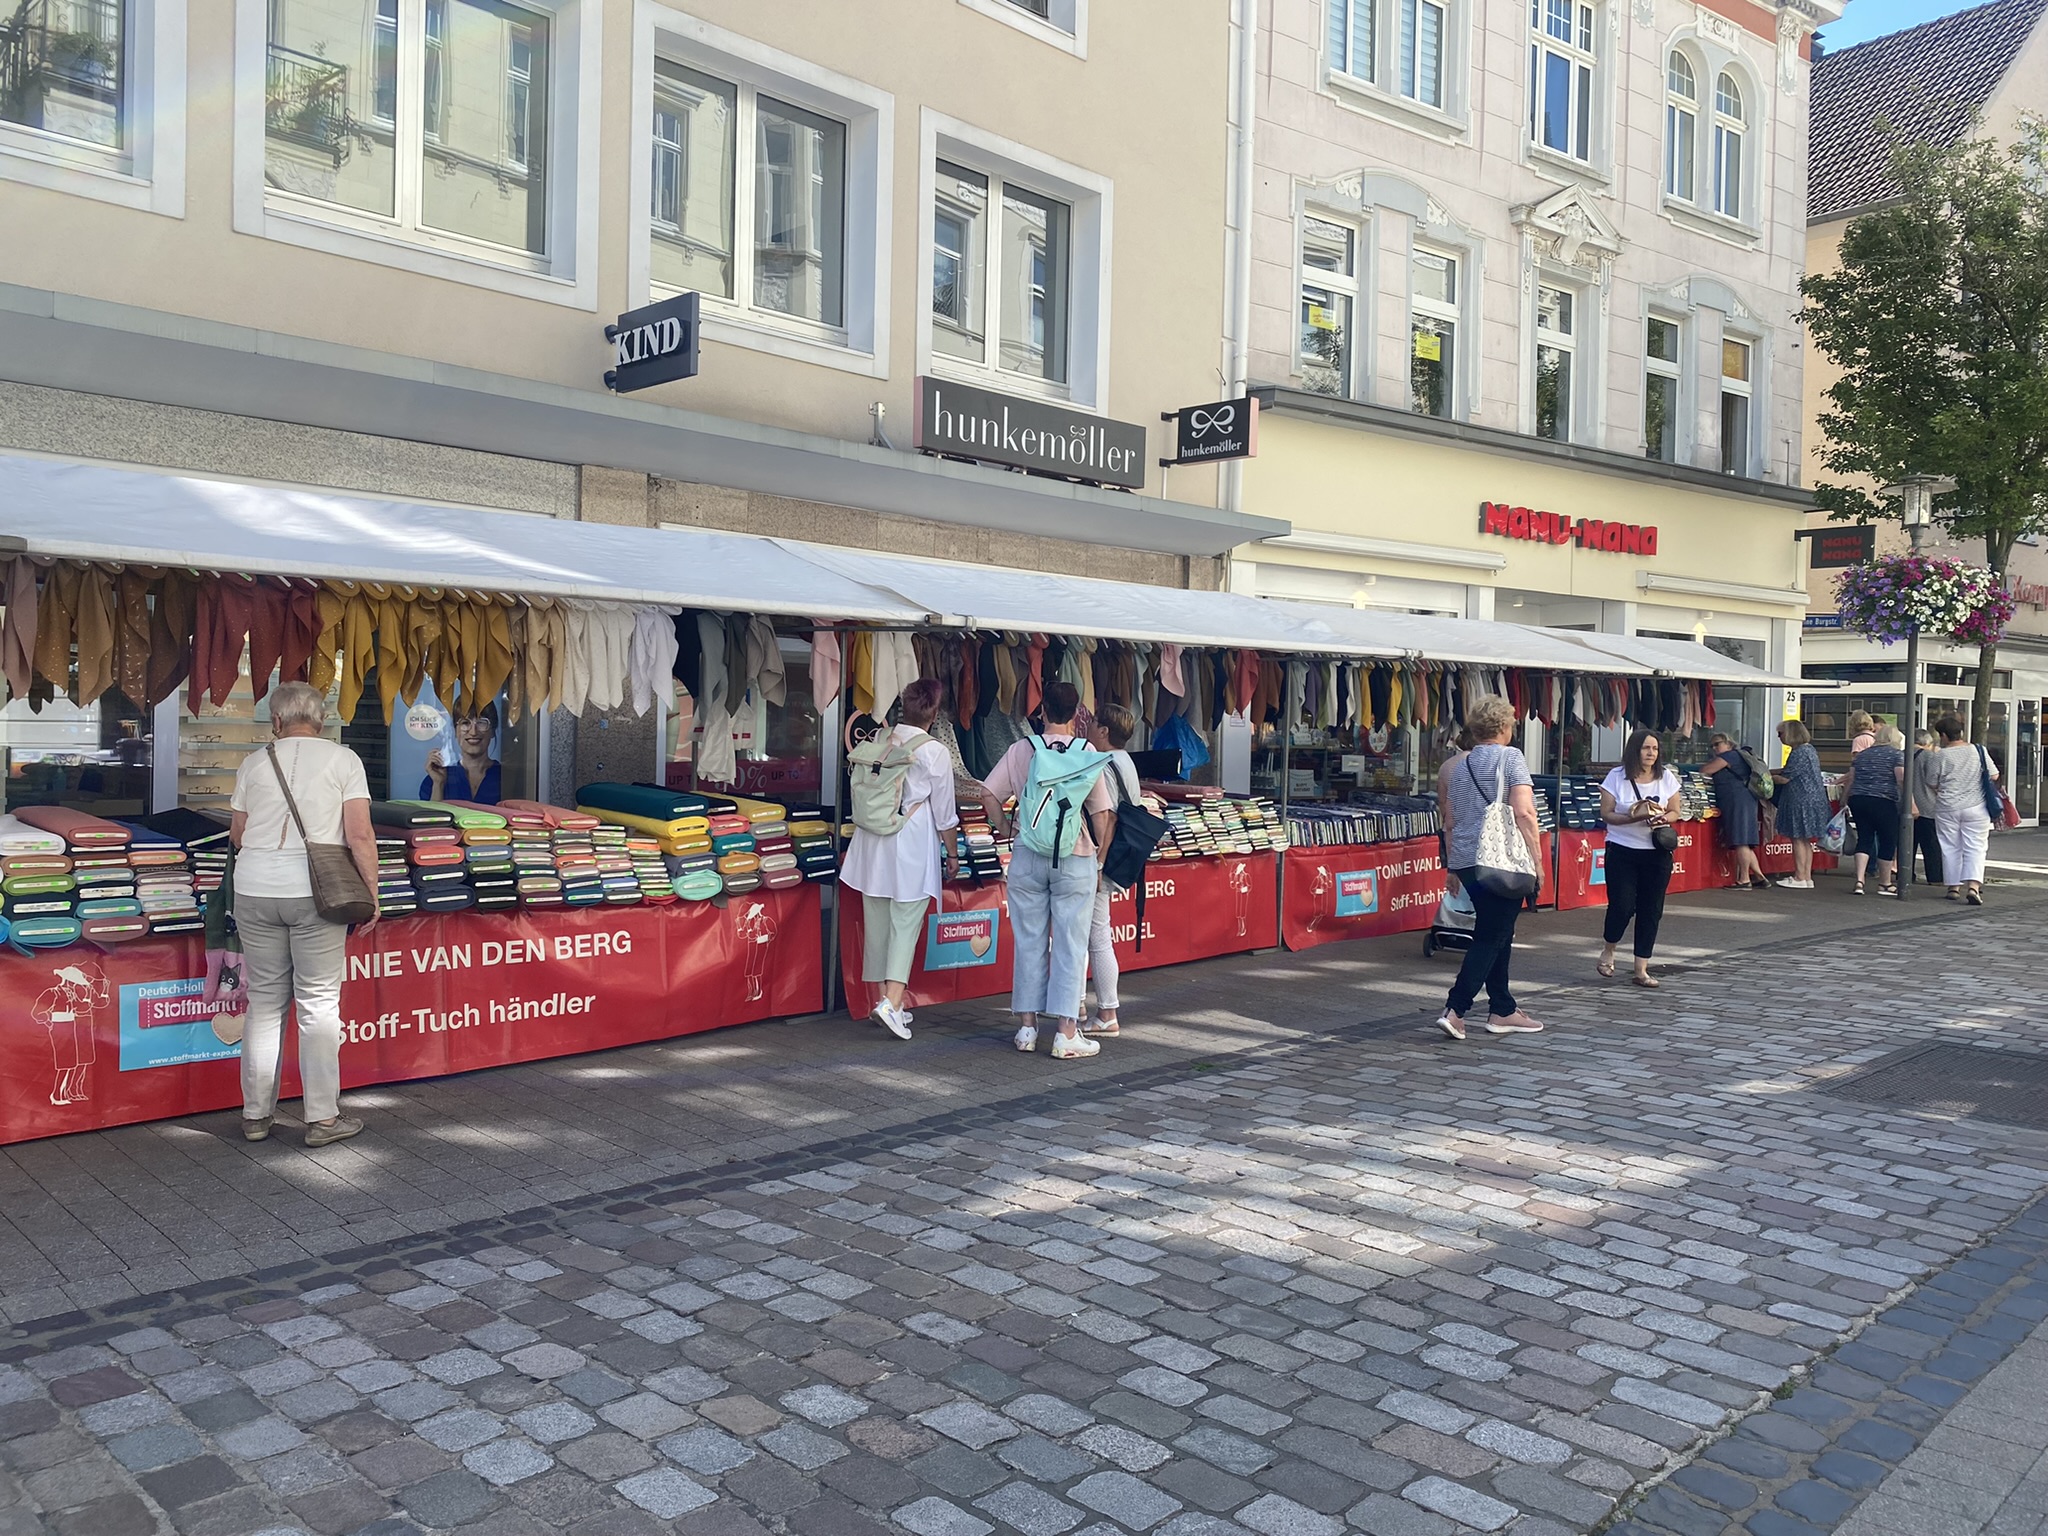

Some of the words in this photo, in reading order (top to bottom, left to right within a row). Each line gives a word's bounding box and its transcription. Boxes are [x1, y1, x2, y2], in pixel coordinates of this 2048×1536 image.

[613, 317, 681, 366] KIND
[934, 390, 1136, 473] hunkemöller
[1181, 439, 1242, 458] hunkemöller
[1815, 618, 1838, 627] Burgstr.
[1786, 691, 1796, 702] 25
[668, 775, 684, 786] UP
[771, 771, 785, 780] UP
[1413, 857, 1432, 873] VAN
[1135, 879, 1175, 899] ERG
[411, 943, 472, 974] VAN
[481, 938, 546, 966] DEN
[554, 930, 632, 960] BERG
[138, 983, 204, 997] Deutsch-Holl
[153, 999, 237, 1019] Stoffmarkt
[489, 992, 596, 1024] händler
